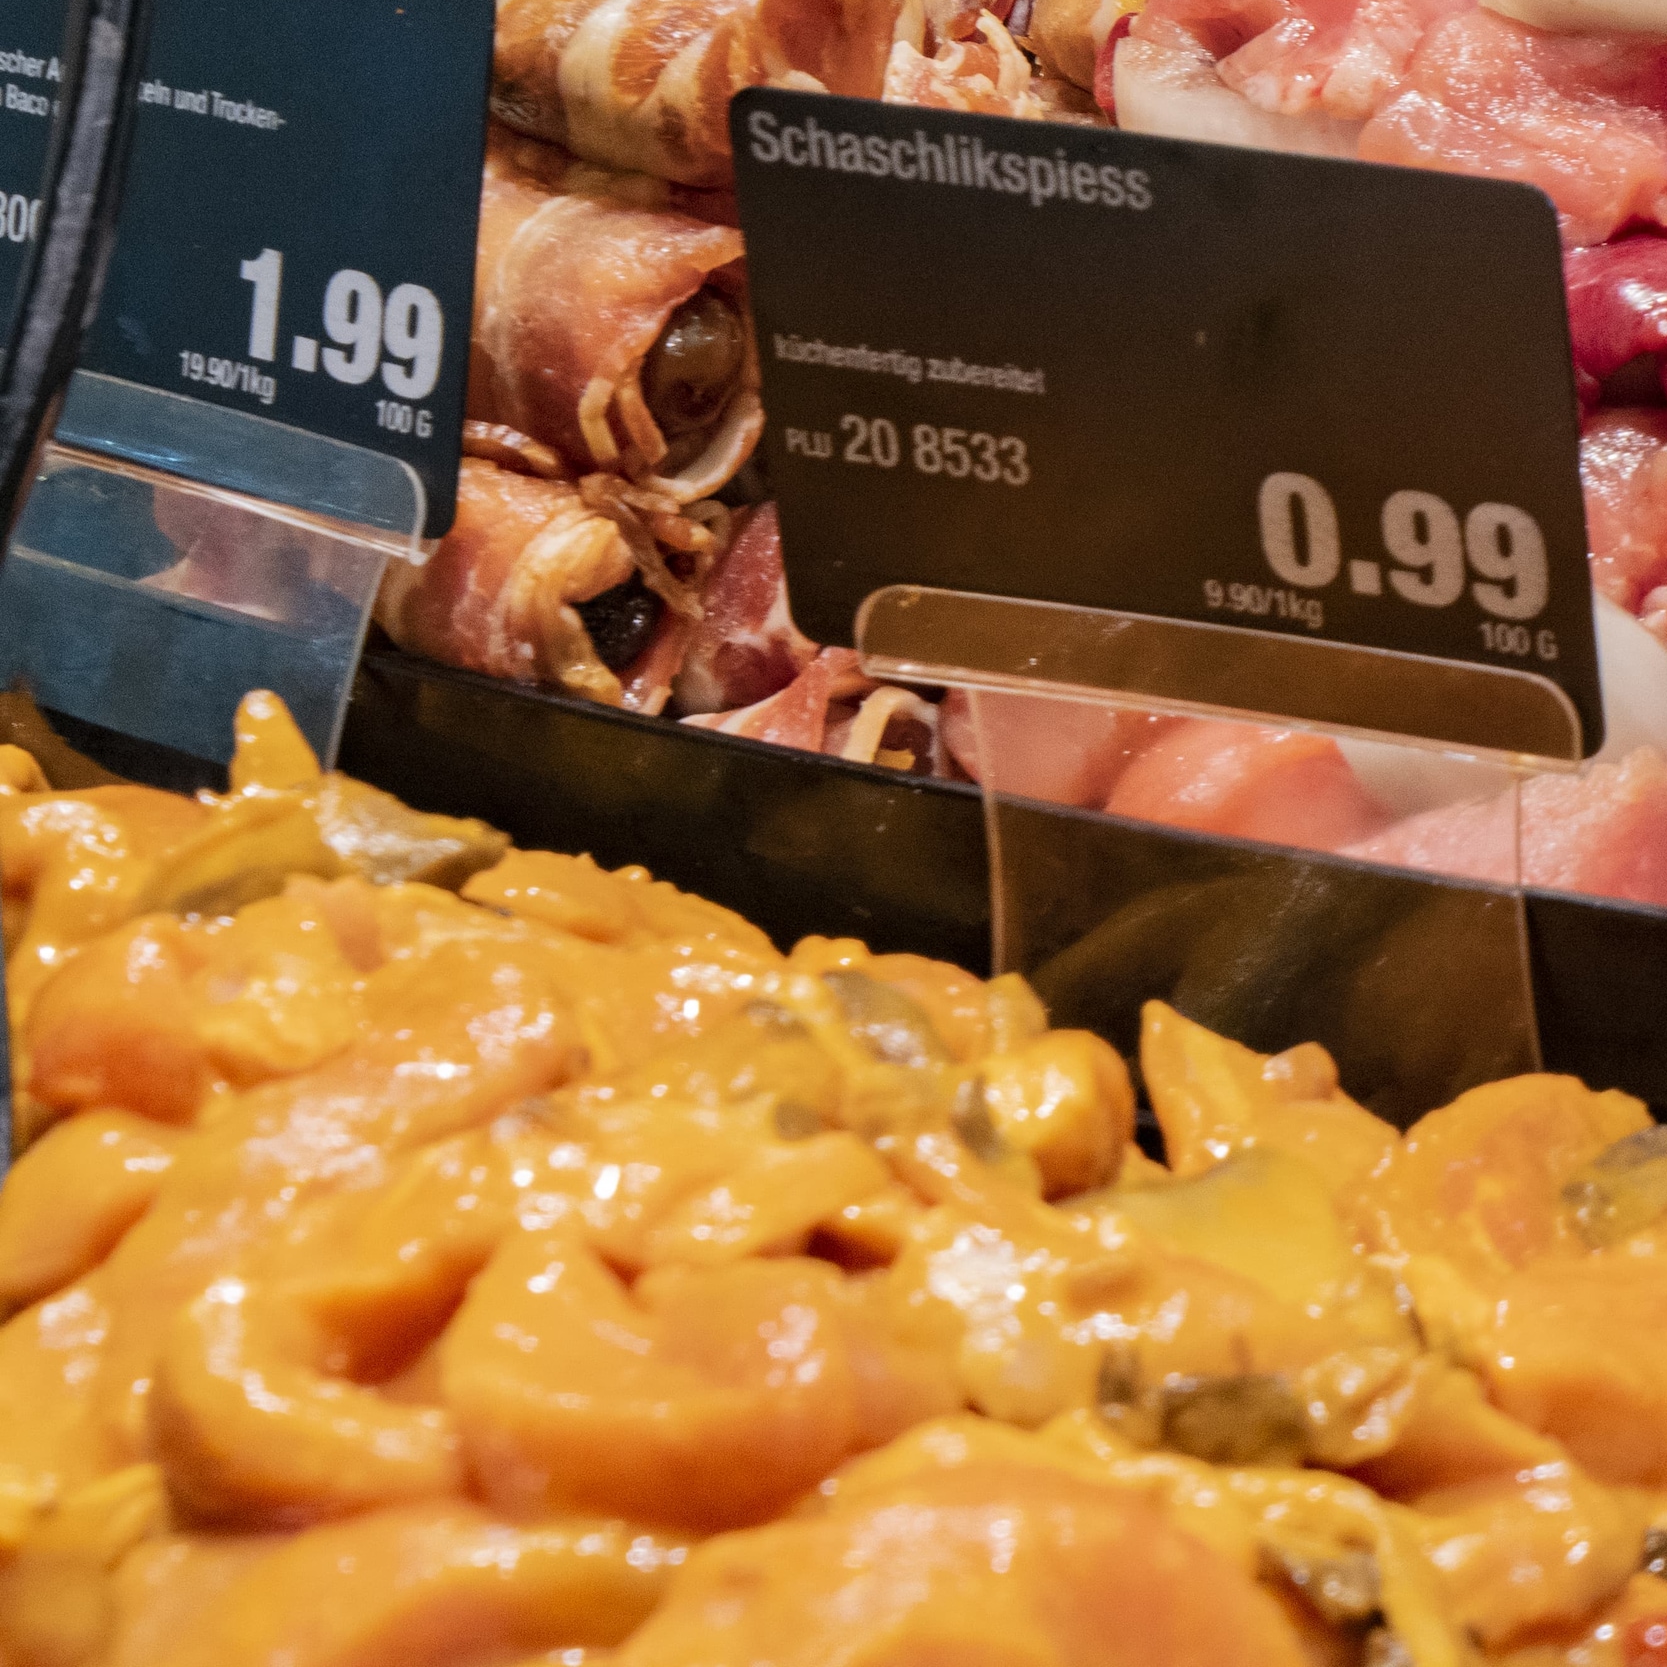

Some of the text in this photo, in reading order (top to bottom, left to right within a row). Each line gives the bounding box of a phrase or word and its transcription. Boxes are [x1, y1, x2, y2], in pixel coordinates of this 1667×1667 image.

[748, 110, 1153, 211] Schaschlikspiess
[239, 247, 445, 400] 1.99
[375, 399, 435, 439] 100 G
[785, 413, 1032, 486] PLU 20 8533
[1258, 471, 1550, 621] 0.99
[1480, 621, 1531, 656] 100
